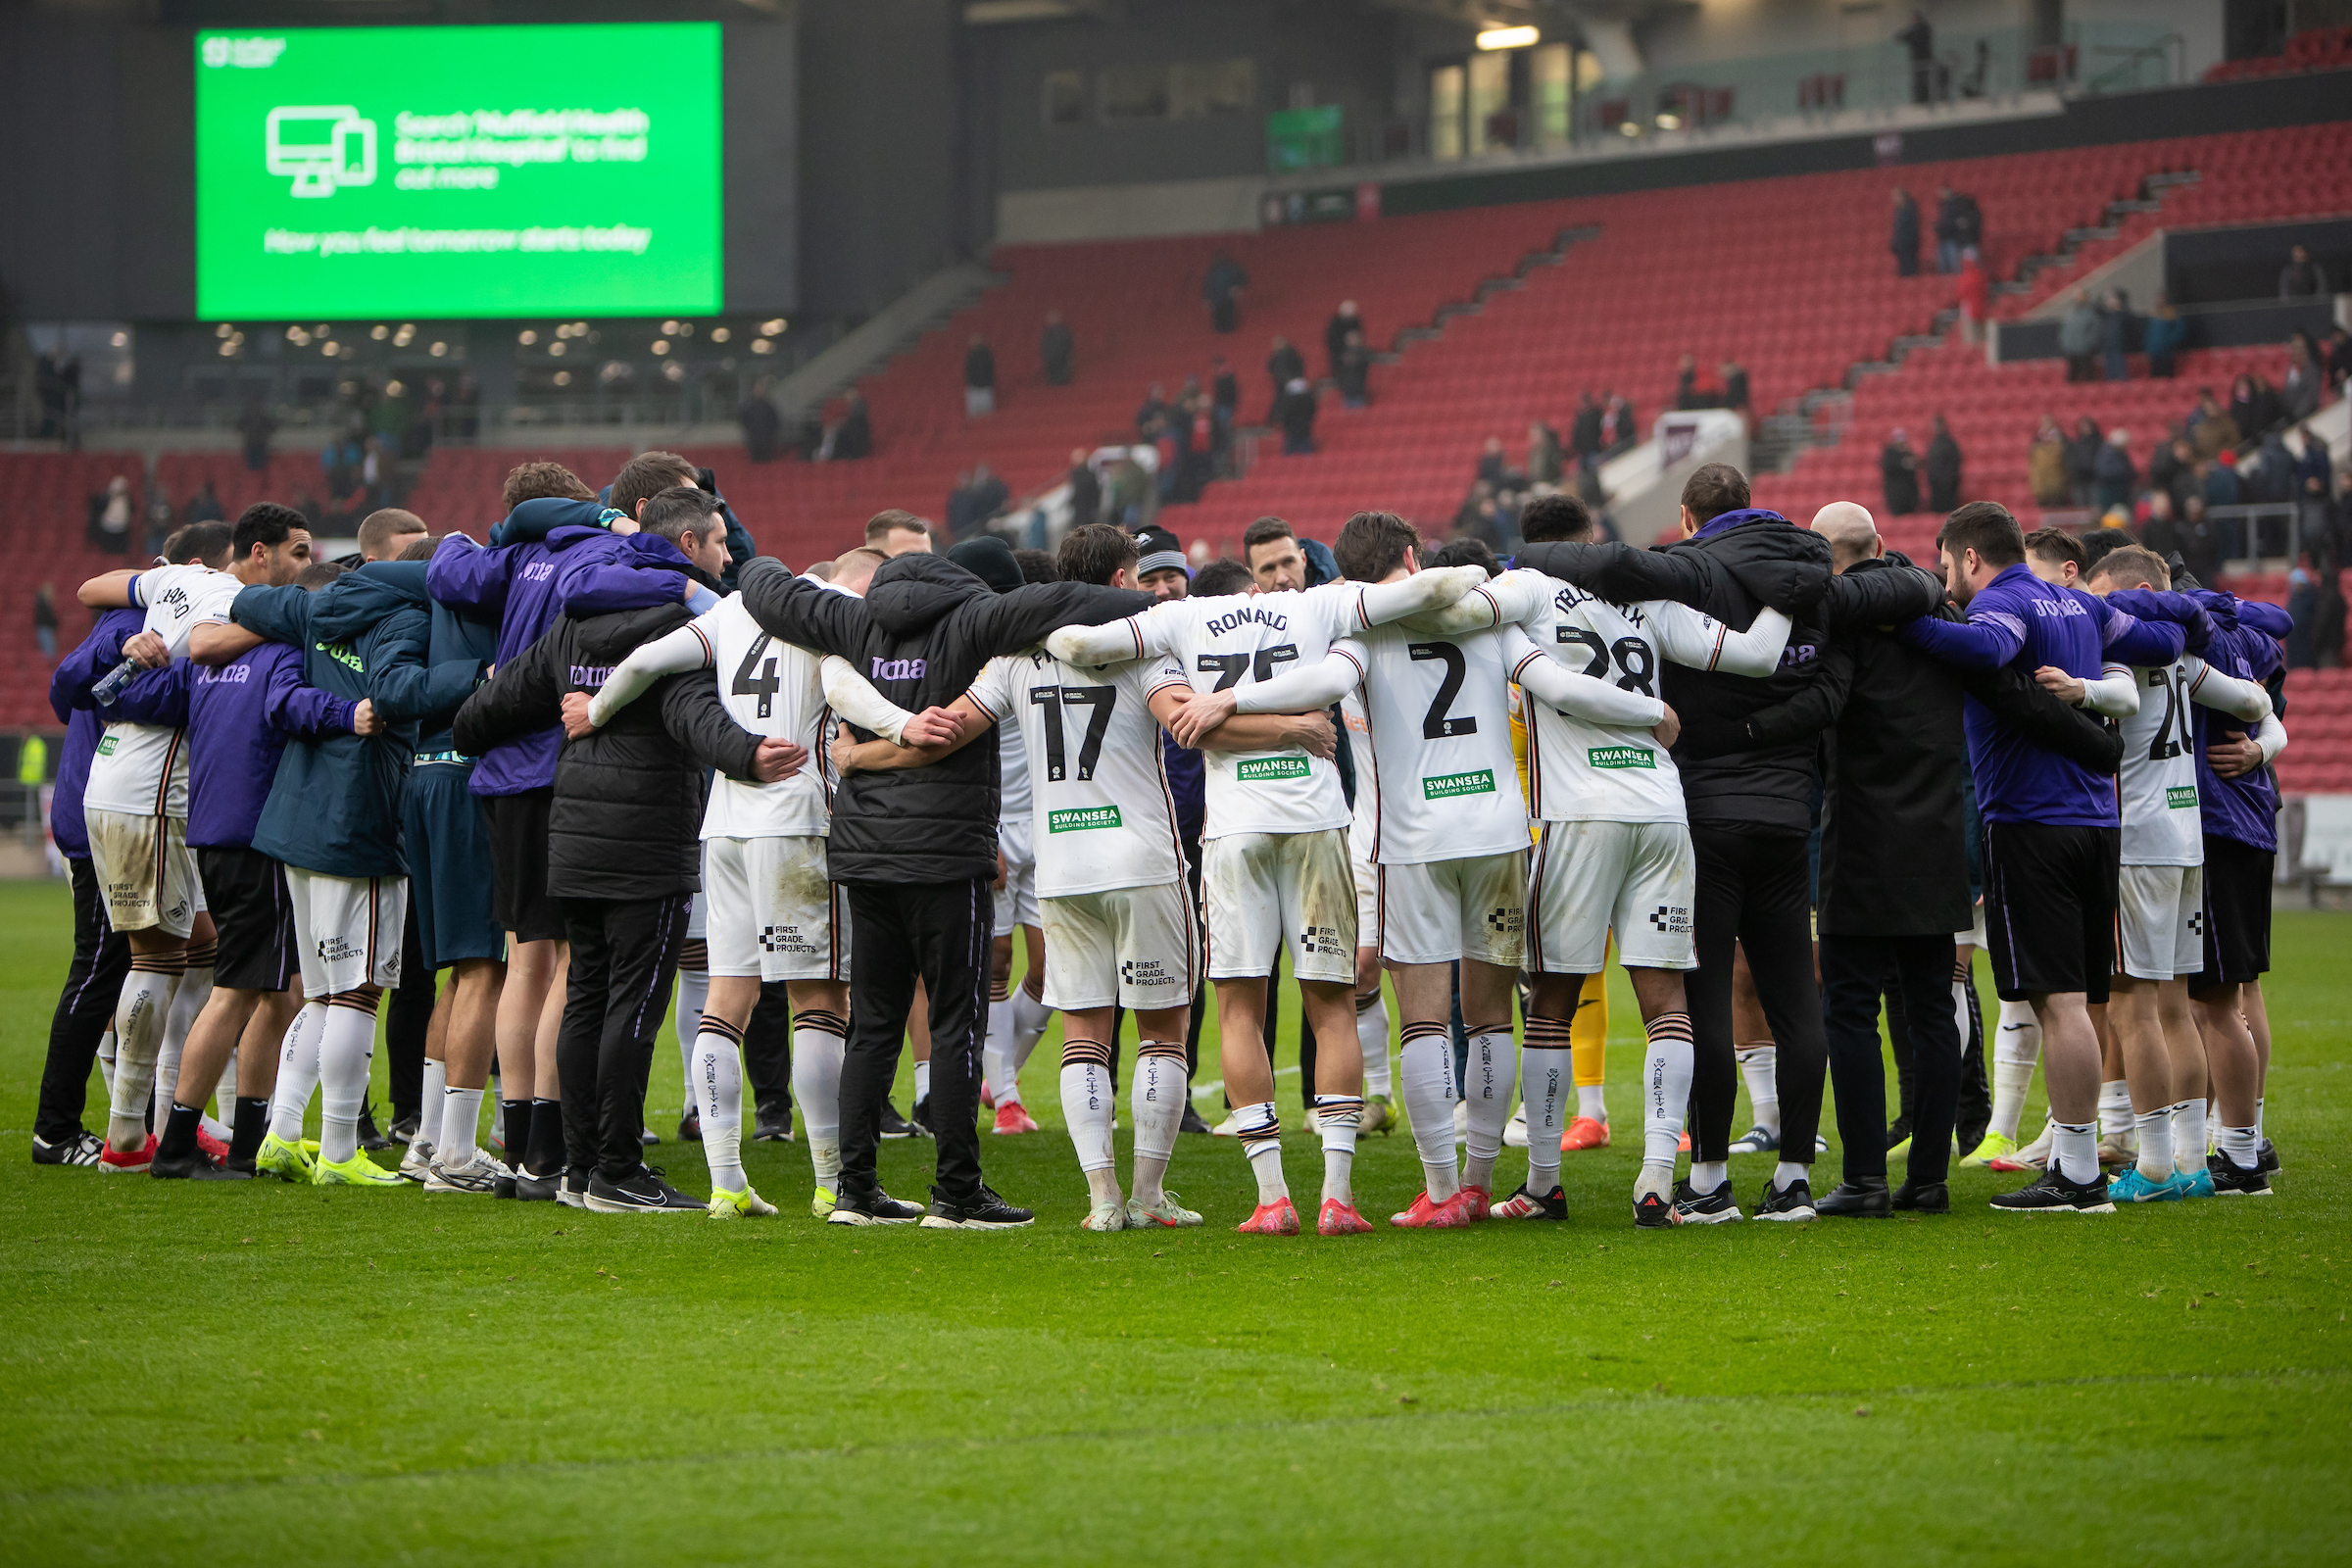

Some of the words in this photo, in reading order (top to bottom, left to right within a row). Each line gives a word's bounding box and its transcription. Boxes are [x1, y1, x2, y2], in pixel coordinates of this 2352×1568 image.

[571, 139, 598, 163] to
[437, 167, 499, 190] more
[586, 222, 652, 256] today
[1206, 607, 1288, 638] RONALD
[732, 630, 780, 719] 4
[1407, 641, 1478, 740] 2
[1029, 684, 1117, 782] 17
[1592, 749, 1651, 762] SWANSEA
[1241, 760, 1305, 774] SWANSEA
[1426, 773, 1491, 791] SWANSEA
[1430, 787, 1460, 797] BUILDING
[1462, 783, 1490, 793] SOCIETY
[1052, 808, 1118, 824] SWANSEA
[324, 936, 344, 946] FIRST
[325, 943, 350, 955] GRADE
[326, 949, 365, 962] PROJECTS
[776, 944, 816, 954] PROJECTS
[1136, 960, 1160, 969] FIRST
[1135, 968, 1165, 978] GRADE
[1136, 976, 1176, 986] PROJECTS
